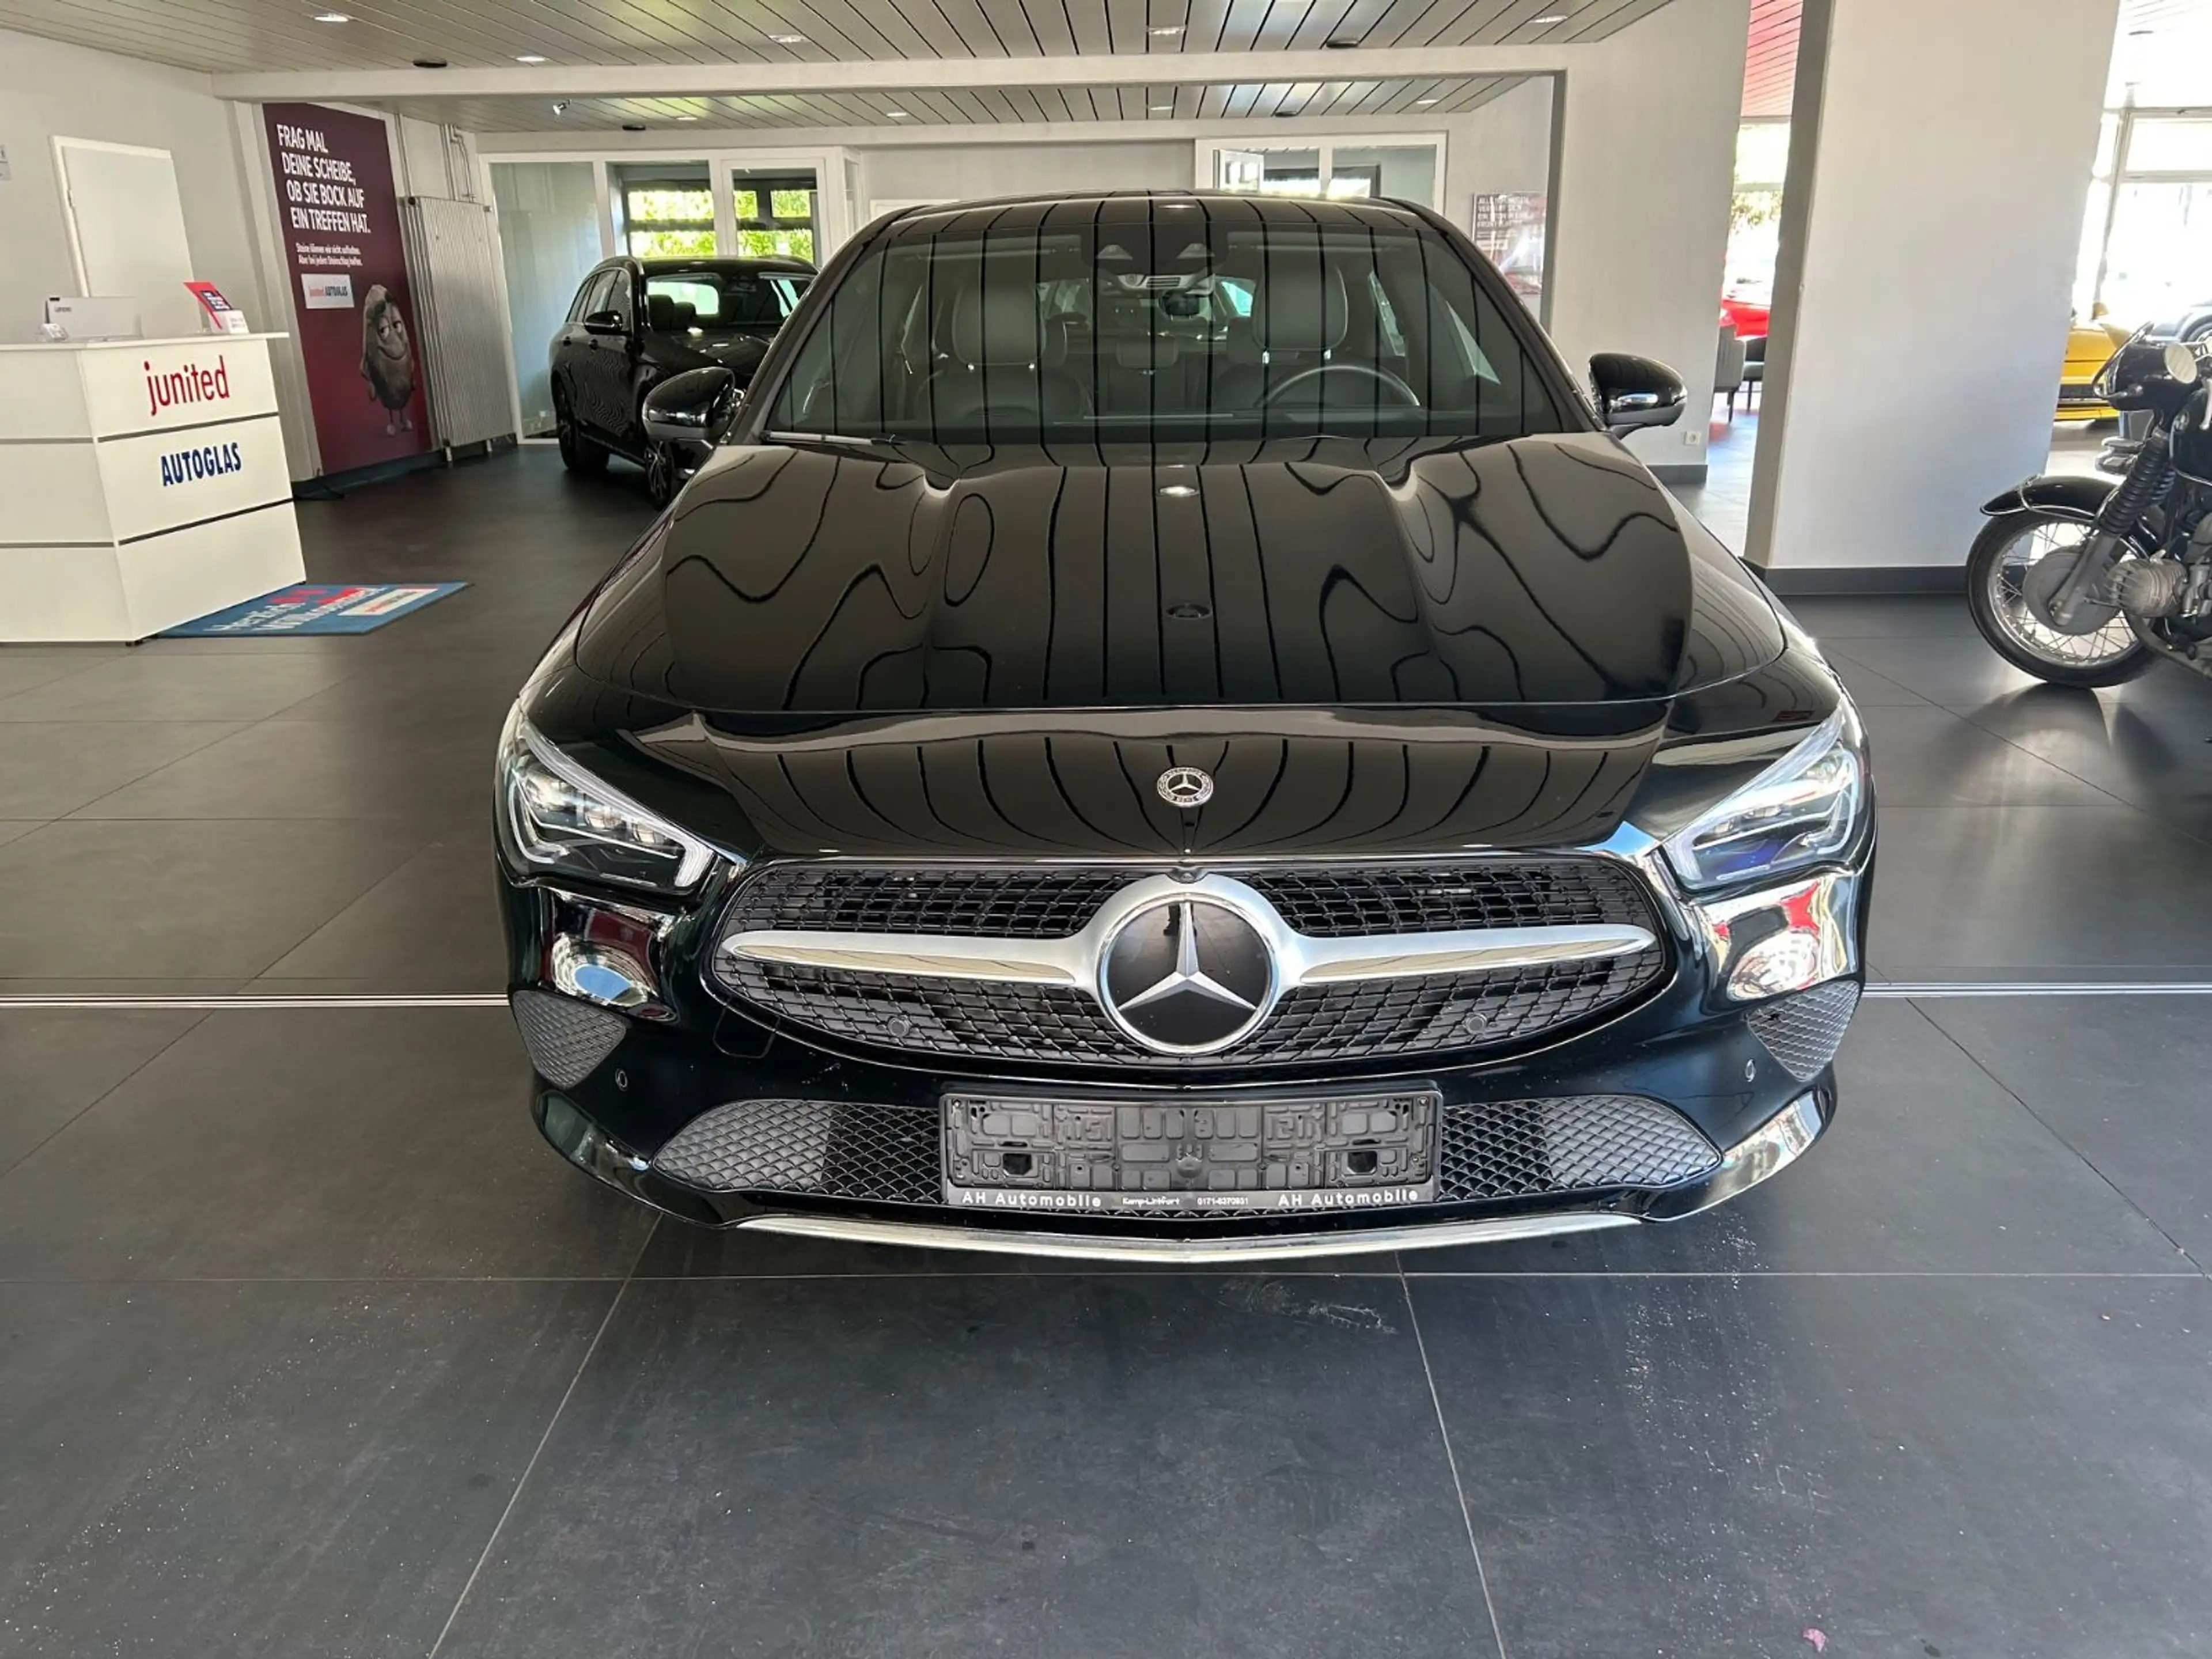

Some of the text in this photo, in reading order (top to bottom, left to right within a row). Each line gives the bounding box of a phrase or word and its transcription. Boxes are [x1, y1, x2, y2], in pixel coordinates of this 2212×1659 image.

[276, 123, 328, 153] FRAG MAL
[281, 151, 356, 185] DEINE SCHEIBE,
[286, 179, 364, 209] OB SIE BOCK AUF
[290, 207, 372, 233] EIN TREFFEN HAT.
[143, 355, 230, 416] junited
[161, 442, 241, 487] AUTOGLAS
[962, 1191, 986, 1205] AH
[995, 1191, 1101, 1207] Automobile
[1278, 1194, 1302, 1207] AH
[1311, 1188, 1418, 1206] Automobile
